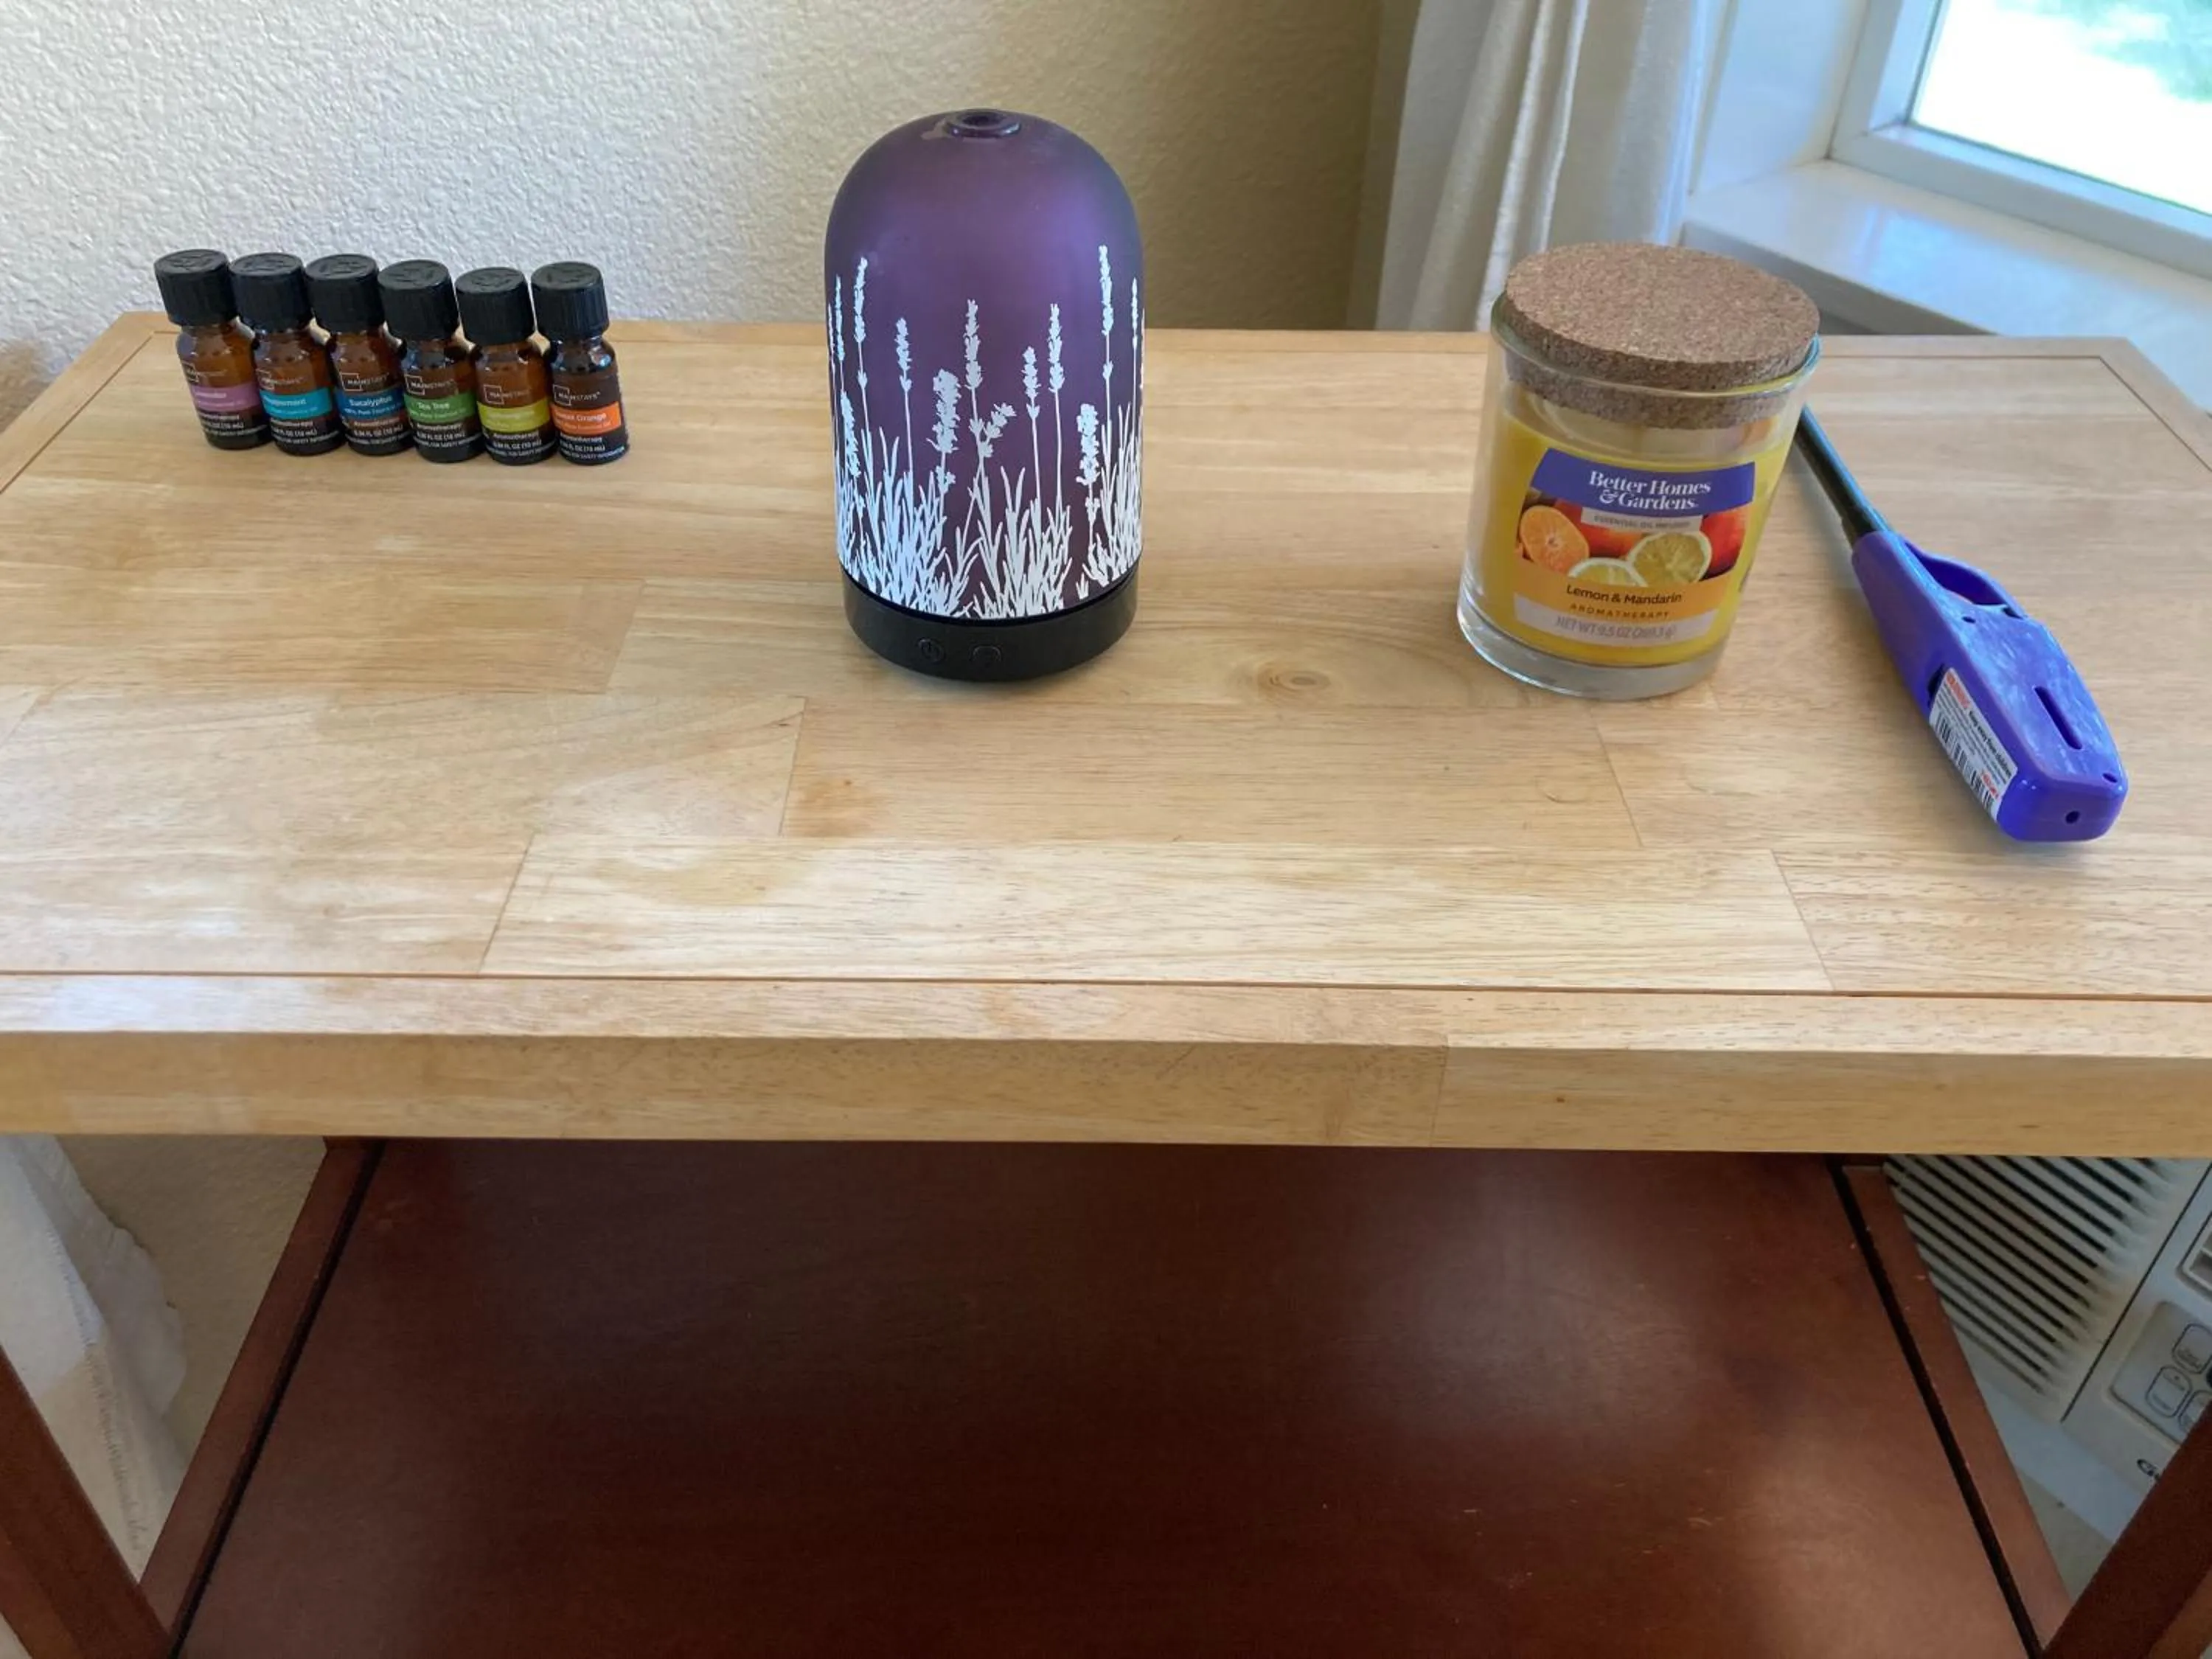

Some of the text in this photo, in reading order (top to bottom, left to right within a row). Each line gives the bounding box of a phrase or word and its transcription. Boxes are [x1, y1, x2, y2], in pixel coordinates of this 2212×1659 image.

[349, 395, 392, 407] Eucalyptus
[558, 392, 598, 400] MAINSTAYS
[417, 402, 450, 410] Tea Tree
[576, 412, 606, 422] Orange
[1589, 470, 1711, 496] Better Homes
[1566, 584, 1682, 605] Lemon & Mandarin
[1570, 603, 1669, 619] AROMATHERAPY
[1557, 615, 1577, 631] NET
[1579, 621, 1596, 633] WT
[1616, 625, 1630, 639] OZ
